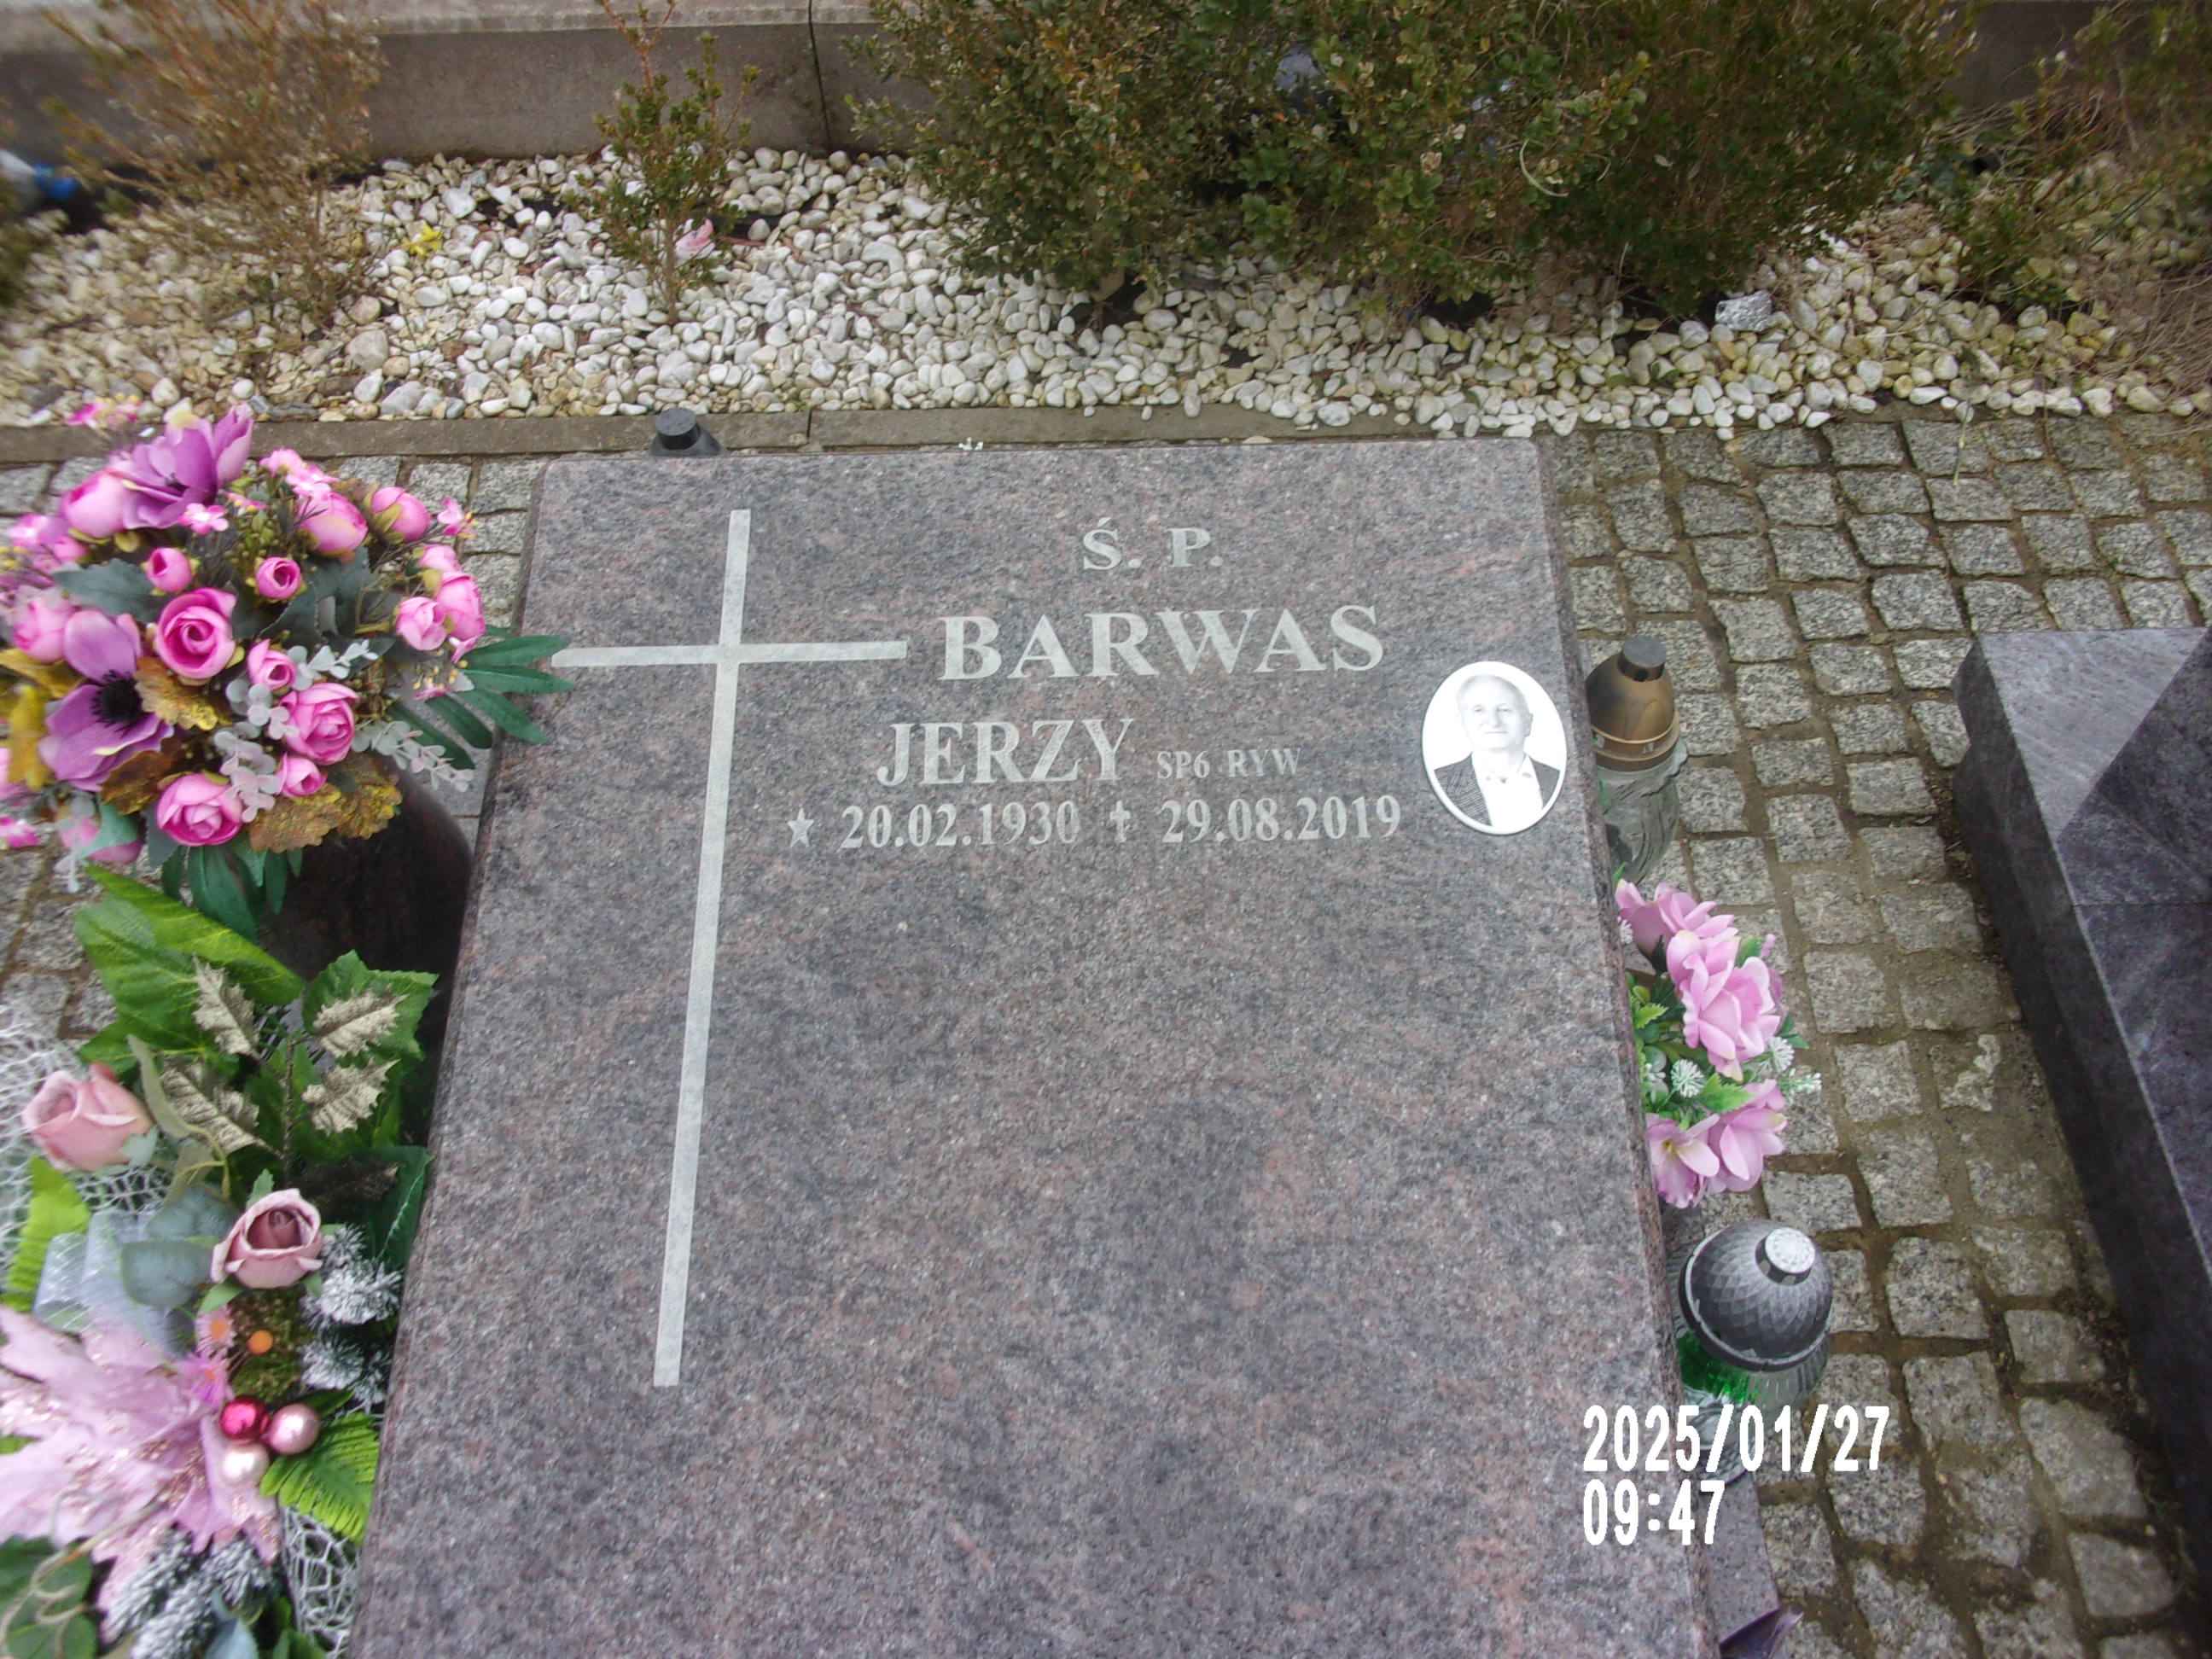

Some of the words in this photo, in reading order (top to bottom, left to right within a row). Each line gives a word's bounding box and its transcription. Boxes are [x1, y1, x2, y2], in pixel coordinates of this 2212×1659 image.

[1081, 516, 1143, 570] Ś.
[1171, 527, 1225, 568] P.
[937, 603, 1385, 682] BARWAS
[876, 718, 1136, 787] JERZY
[1156, 749, 1211, 781] SP6
[1227, 747, 1302, 778] RYW
[840, 800, 1080, 850] 20.02.1930
[1160, 794, 1401, 845] 29.08.2019
